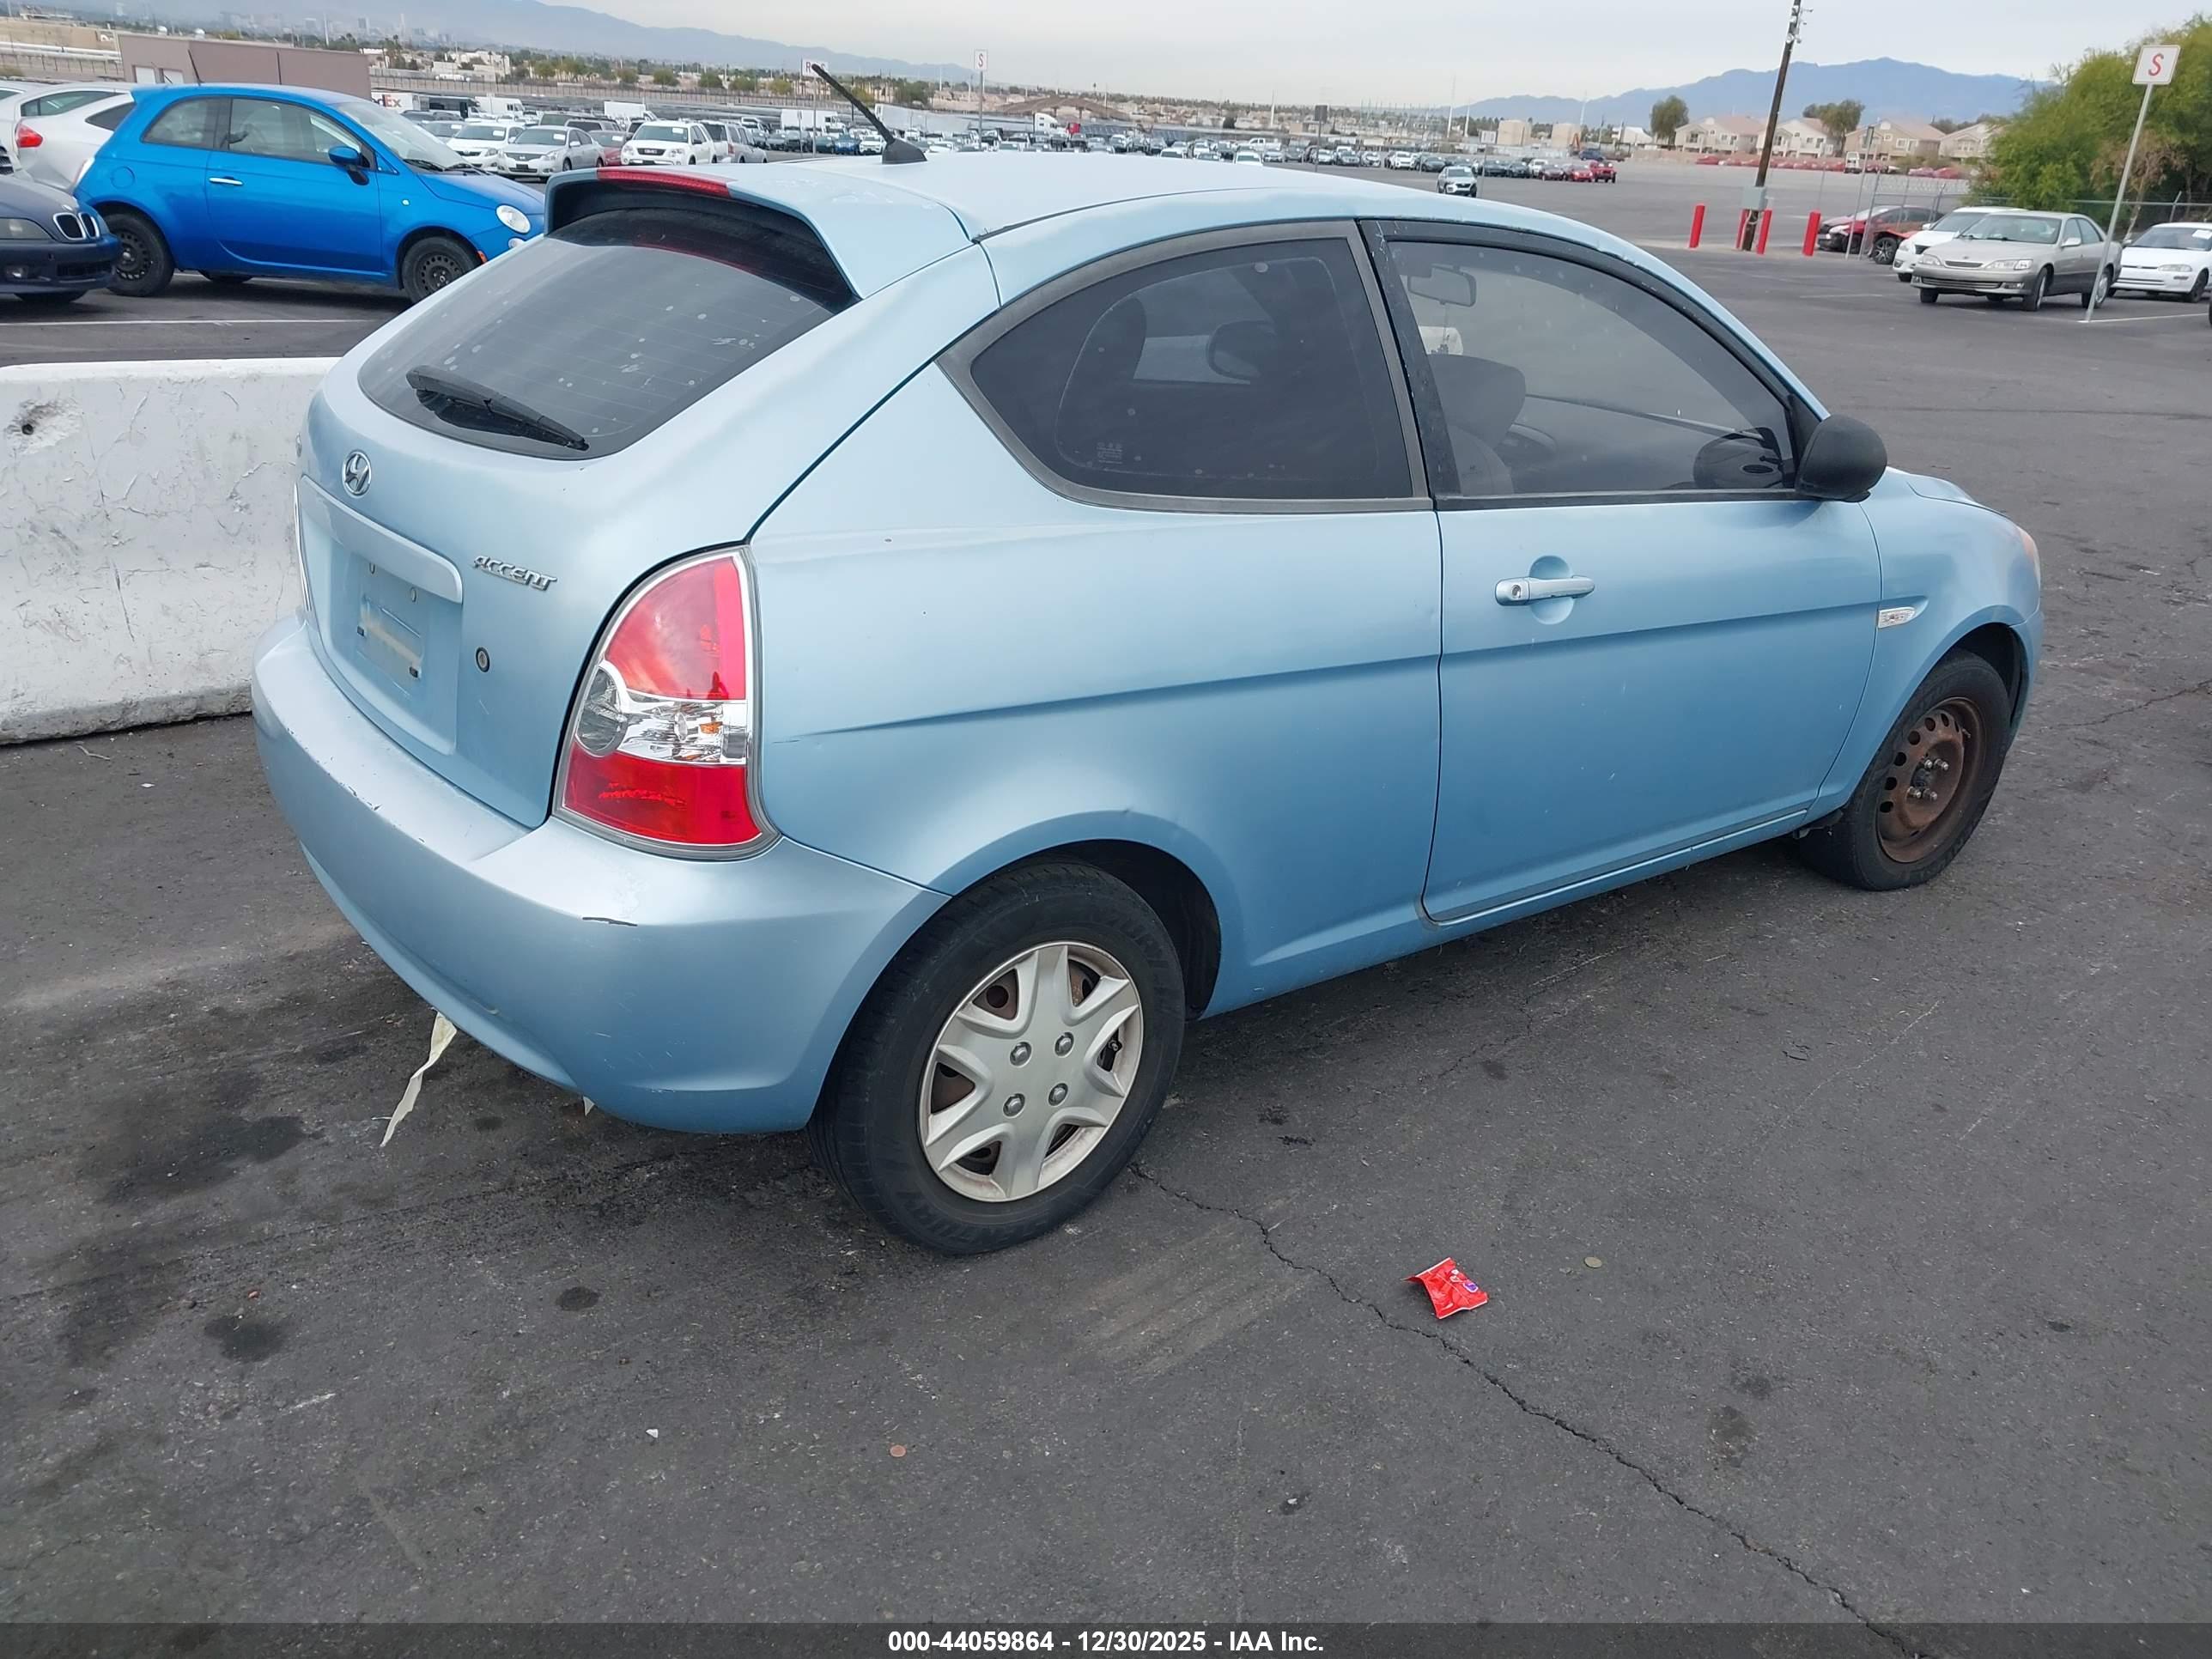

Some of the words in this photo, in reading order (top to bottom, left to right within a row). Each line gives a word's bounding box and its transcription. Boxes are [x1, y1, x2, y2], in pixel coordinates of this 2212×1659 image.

[977, 52, 985, 68] S
[2148, 52, 2165, 76] S
[473, 555, 557, 591] ACCENT
